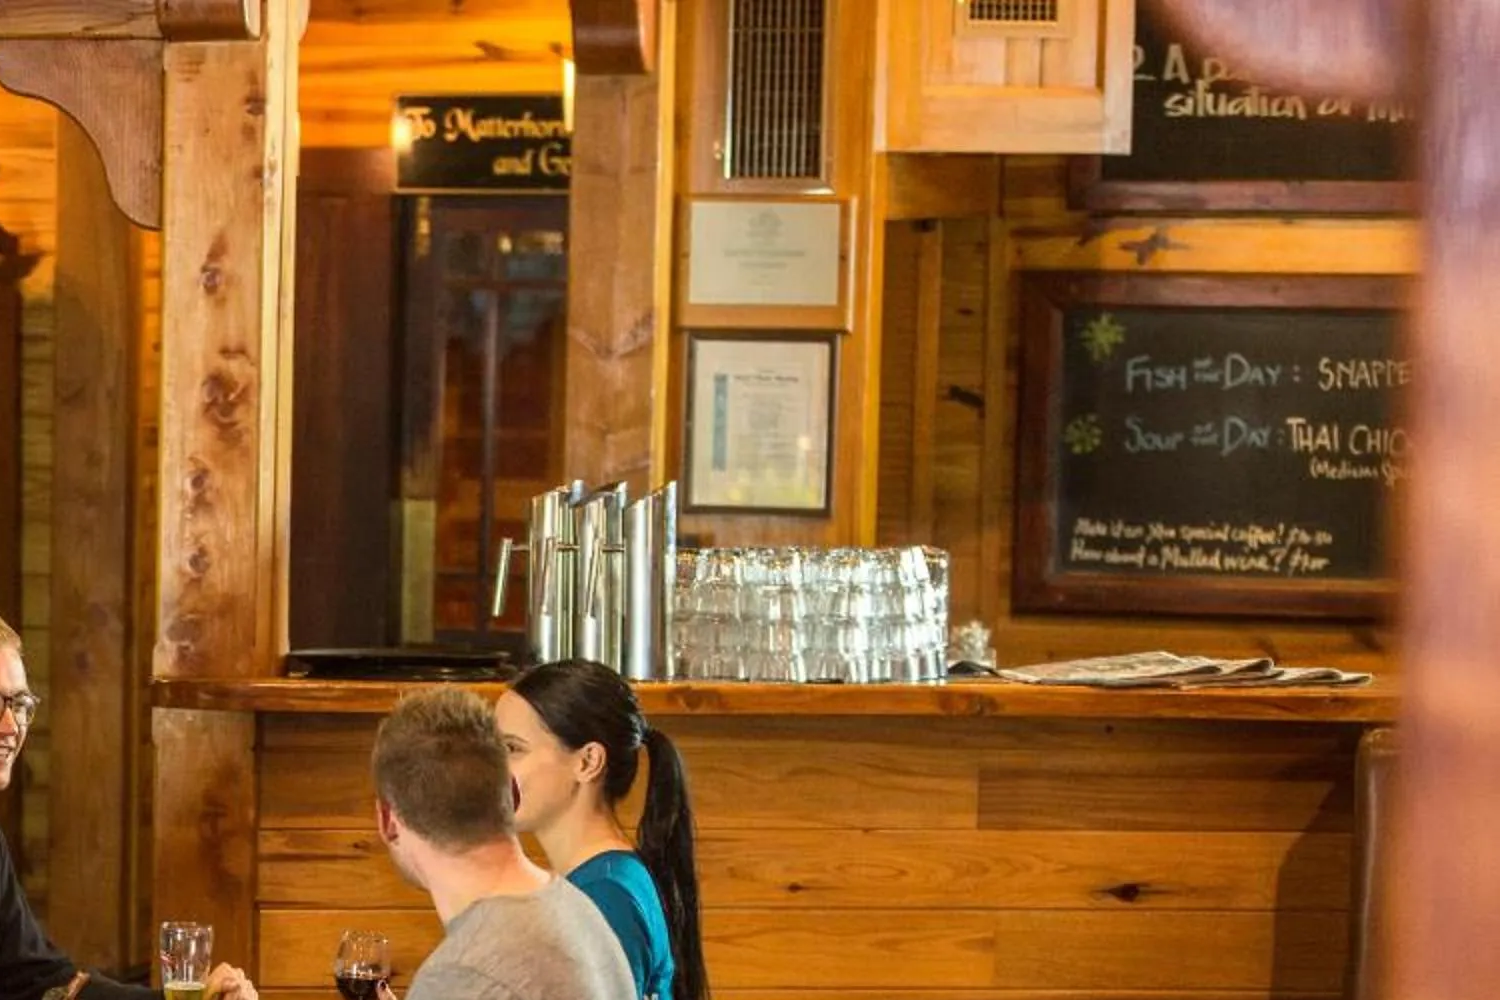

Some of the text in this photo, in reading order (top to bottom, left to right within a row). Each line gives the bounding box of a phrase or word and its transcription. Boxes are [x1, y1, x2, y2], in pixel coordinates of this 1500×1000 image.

[1164, 79, 1307, 121] situation
[493, 149, 534, 176] and
[1286, 416, 1340, 454] THAI
